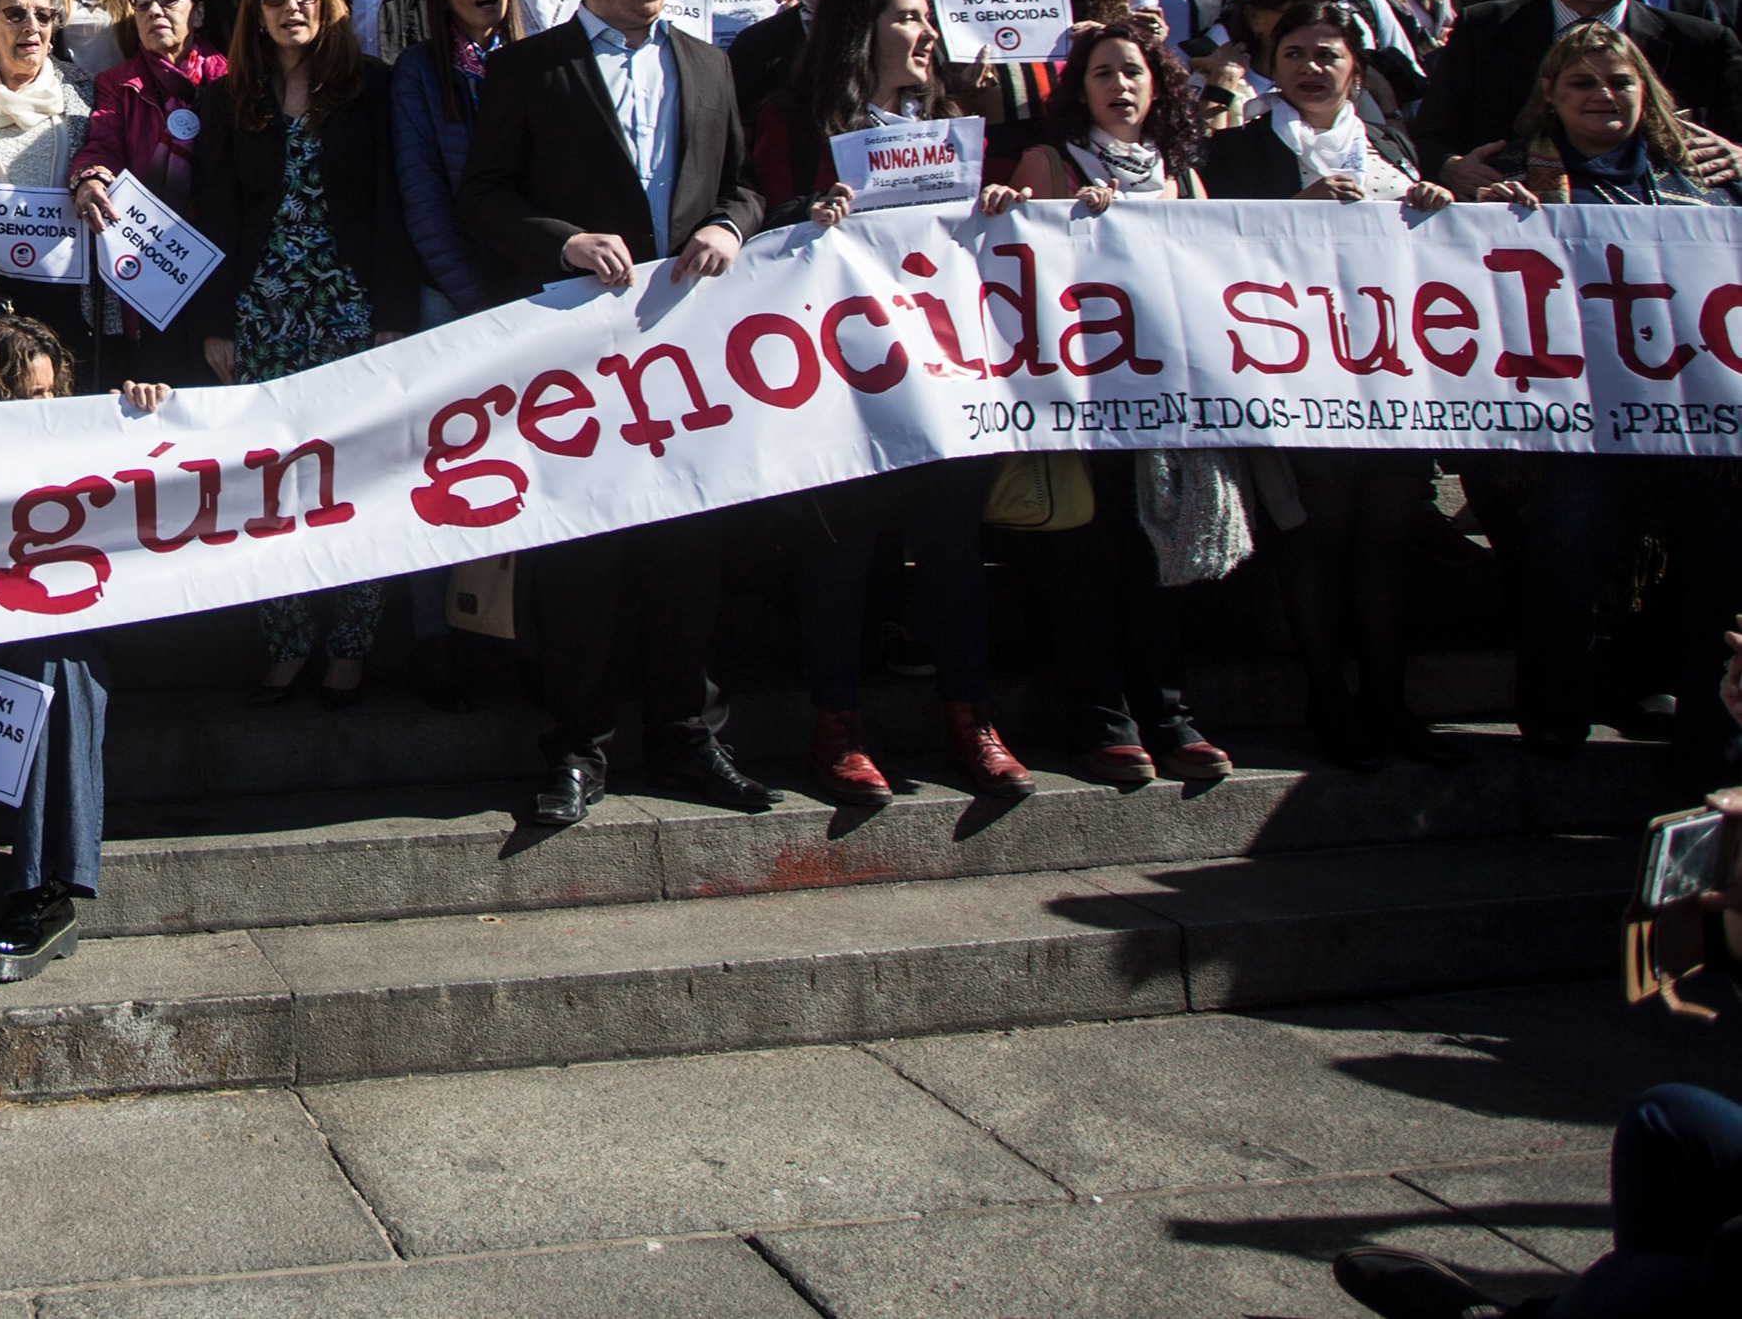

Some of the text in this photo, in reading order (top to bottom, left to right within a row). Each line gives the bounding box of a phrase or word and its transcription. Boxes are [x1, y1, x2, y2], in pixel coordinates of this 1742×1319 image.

[949, 7, 1060, 23] DE GENOCIDAS
[868, 138, 956, 172] NUNCA MÁS
[14, 205, 31, 218] AL
[38, 206, 62, 220] 2X1
[126, 205, 190, 262] NO AL 2X1
[121, 225, 188, 286] GENOCIDAS
[410, 242, 1165, 529] genocida
[1052, 391, 1595, 434] DETENIDOS-DESAPARECIDOS
[1609, 402, 1742, 442] ¡PRES
